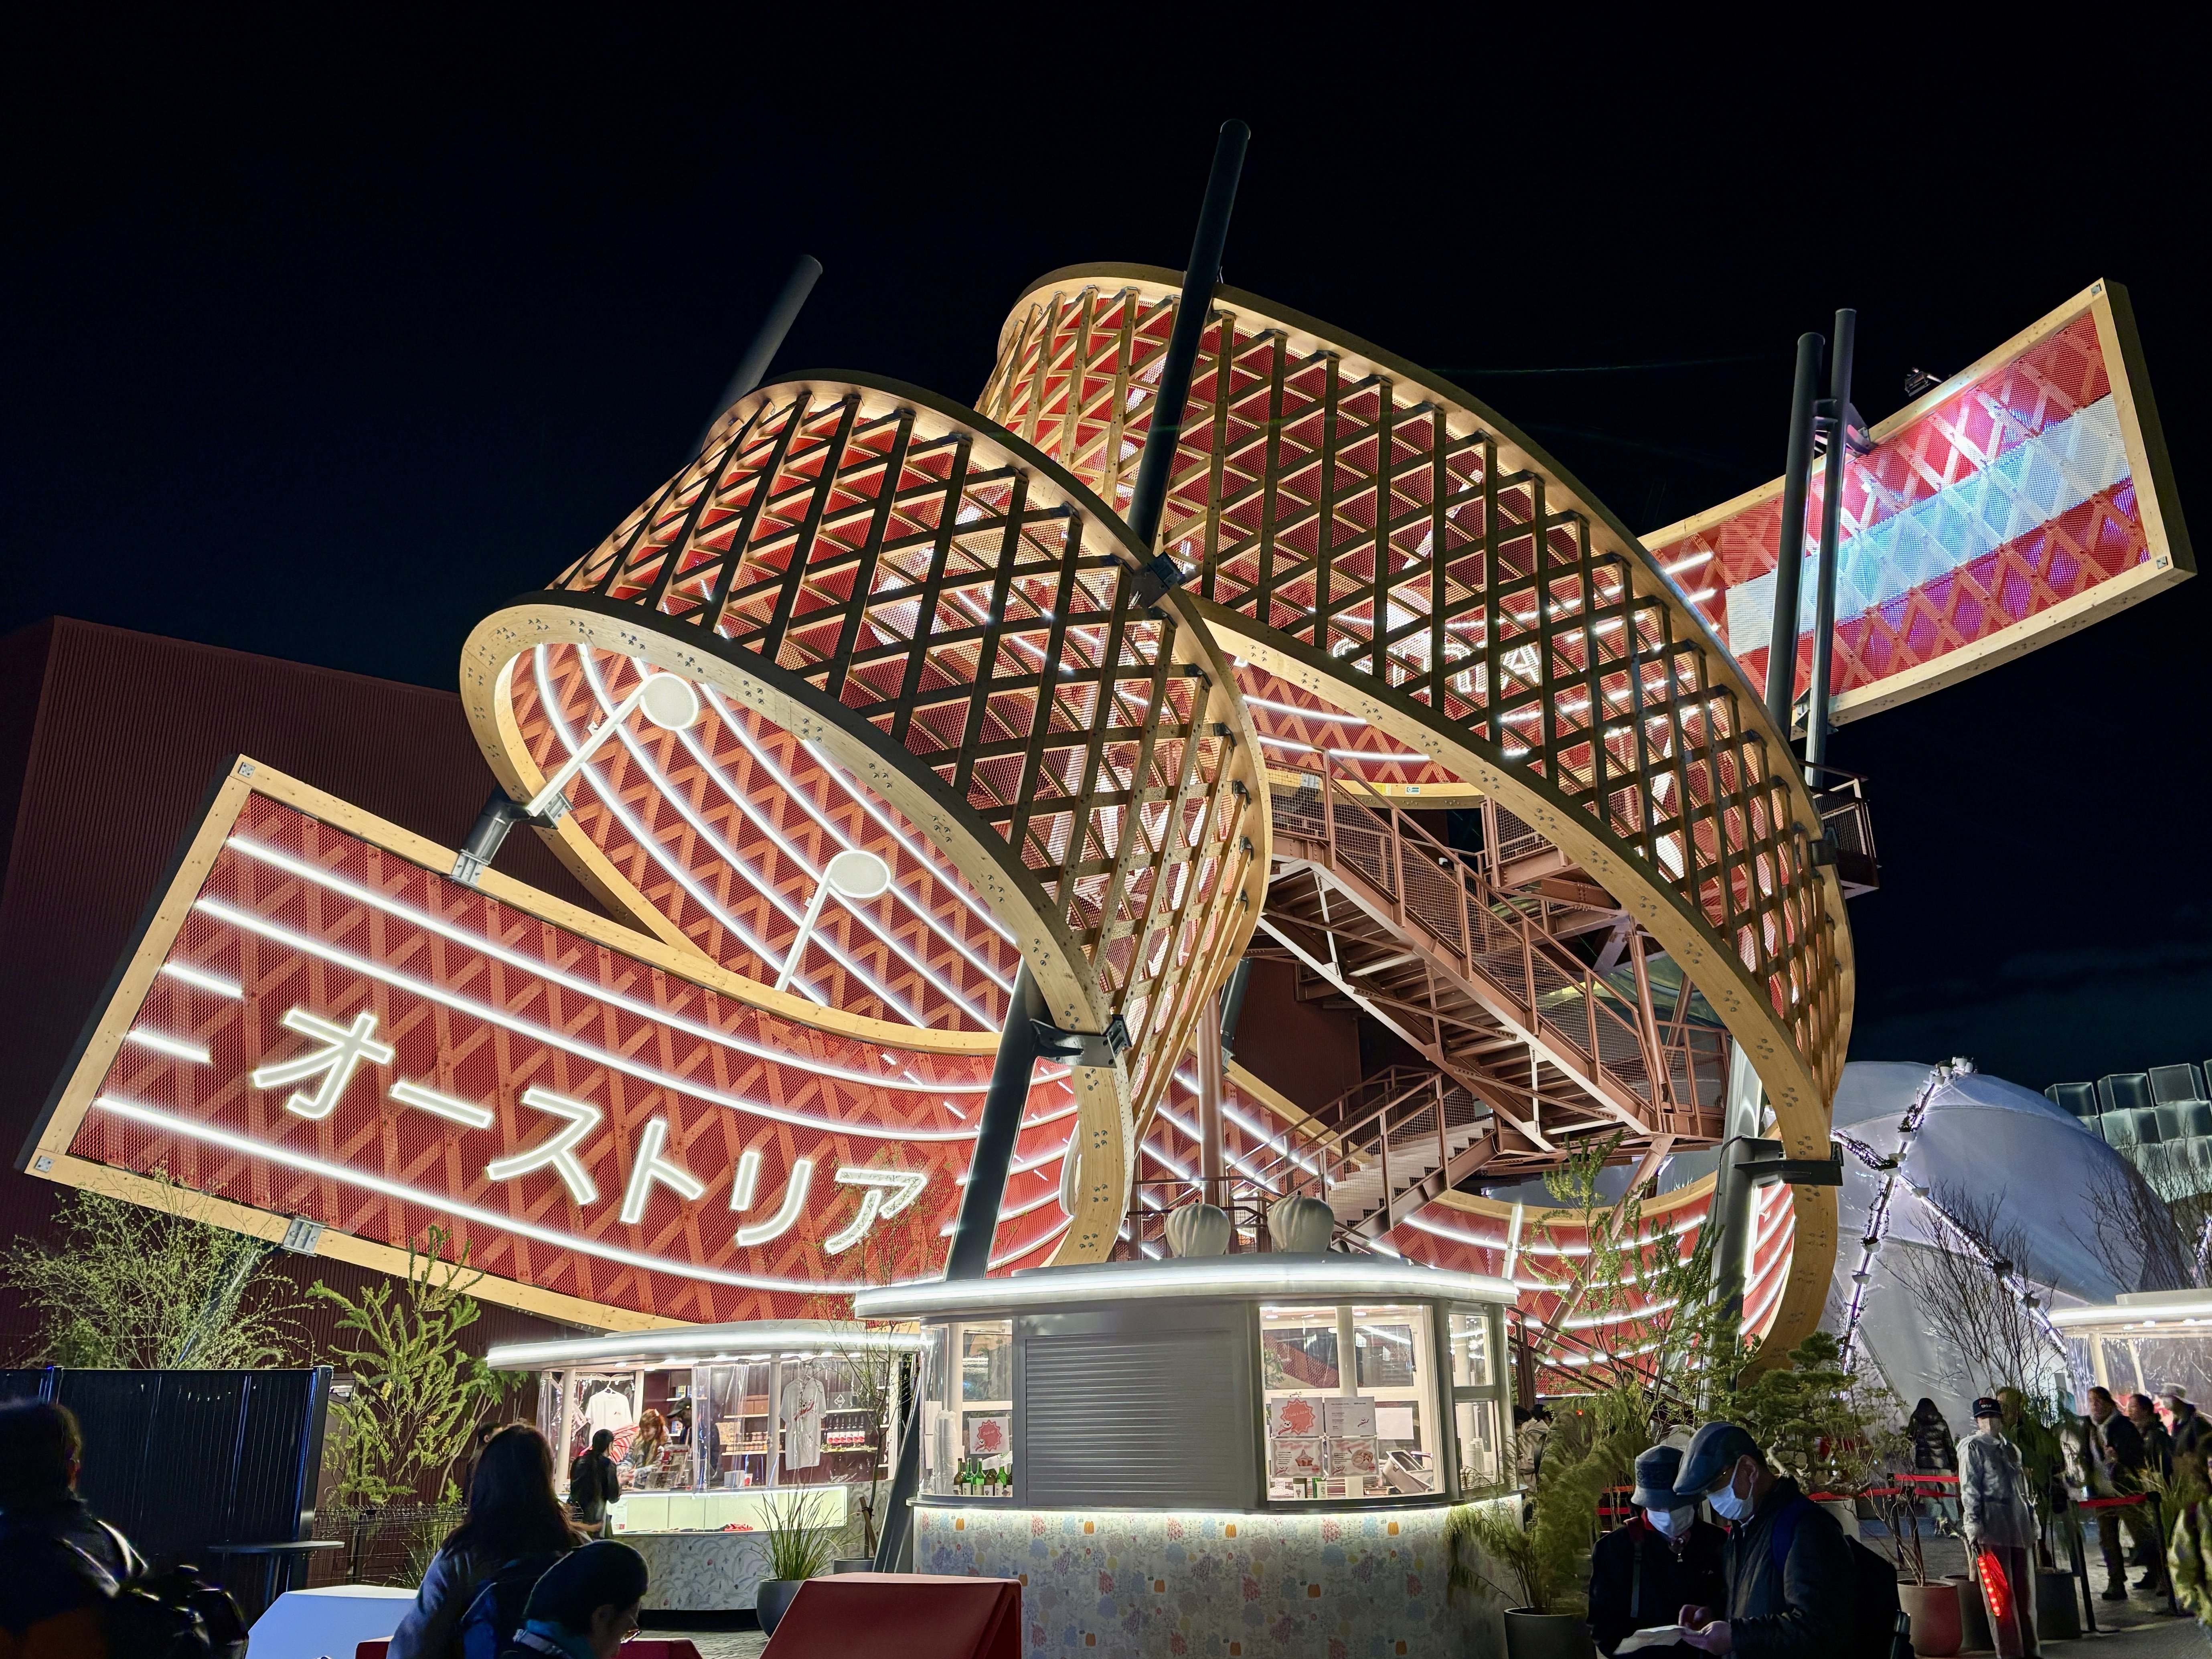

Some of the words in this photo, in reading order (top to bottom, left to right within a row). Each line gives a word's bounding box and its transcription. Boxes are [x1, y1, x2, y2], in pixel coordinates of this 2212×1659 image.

[253, 1009, 926, 1255] オーストリア
